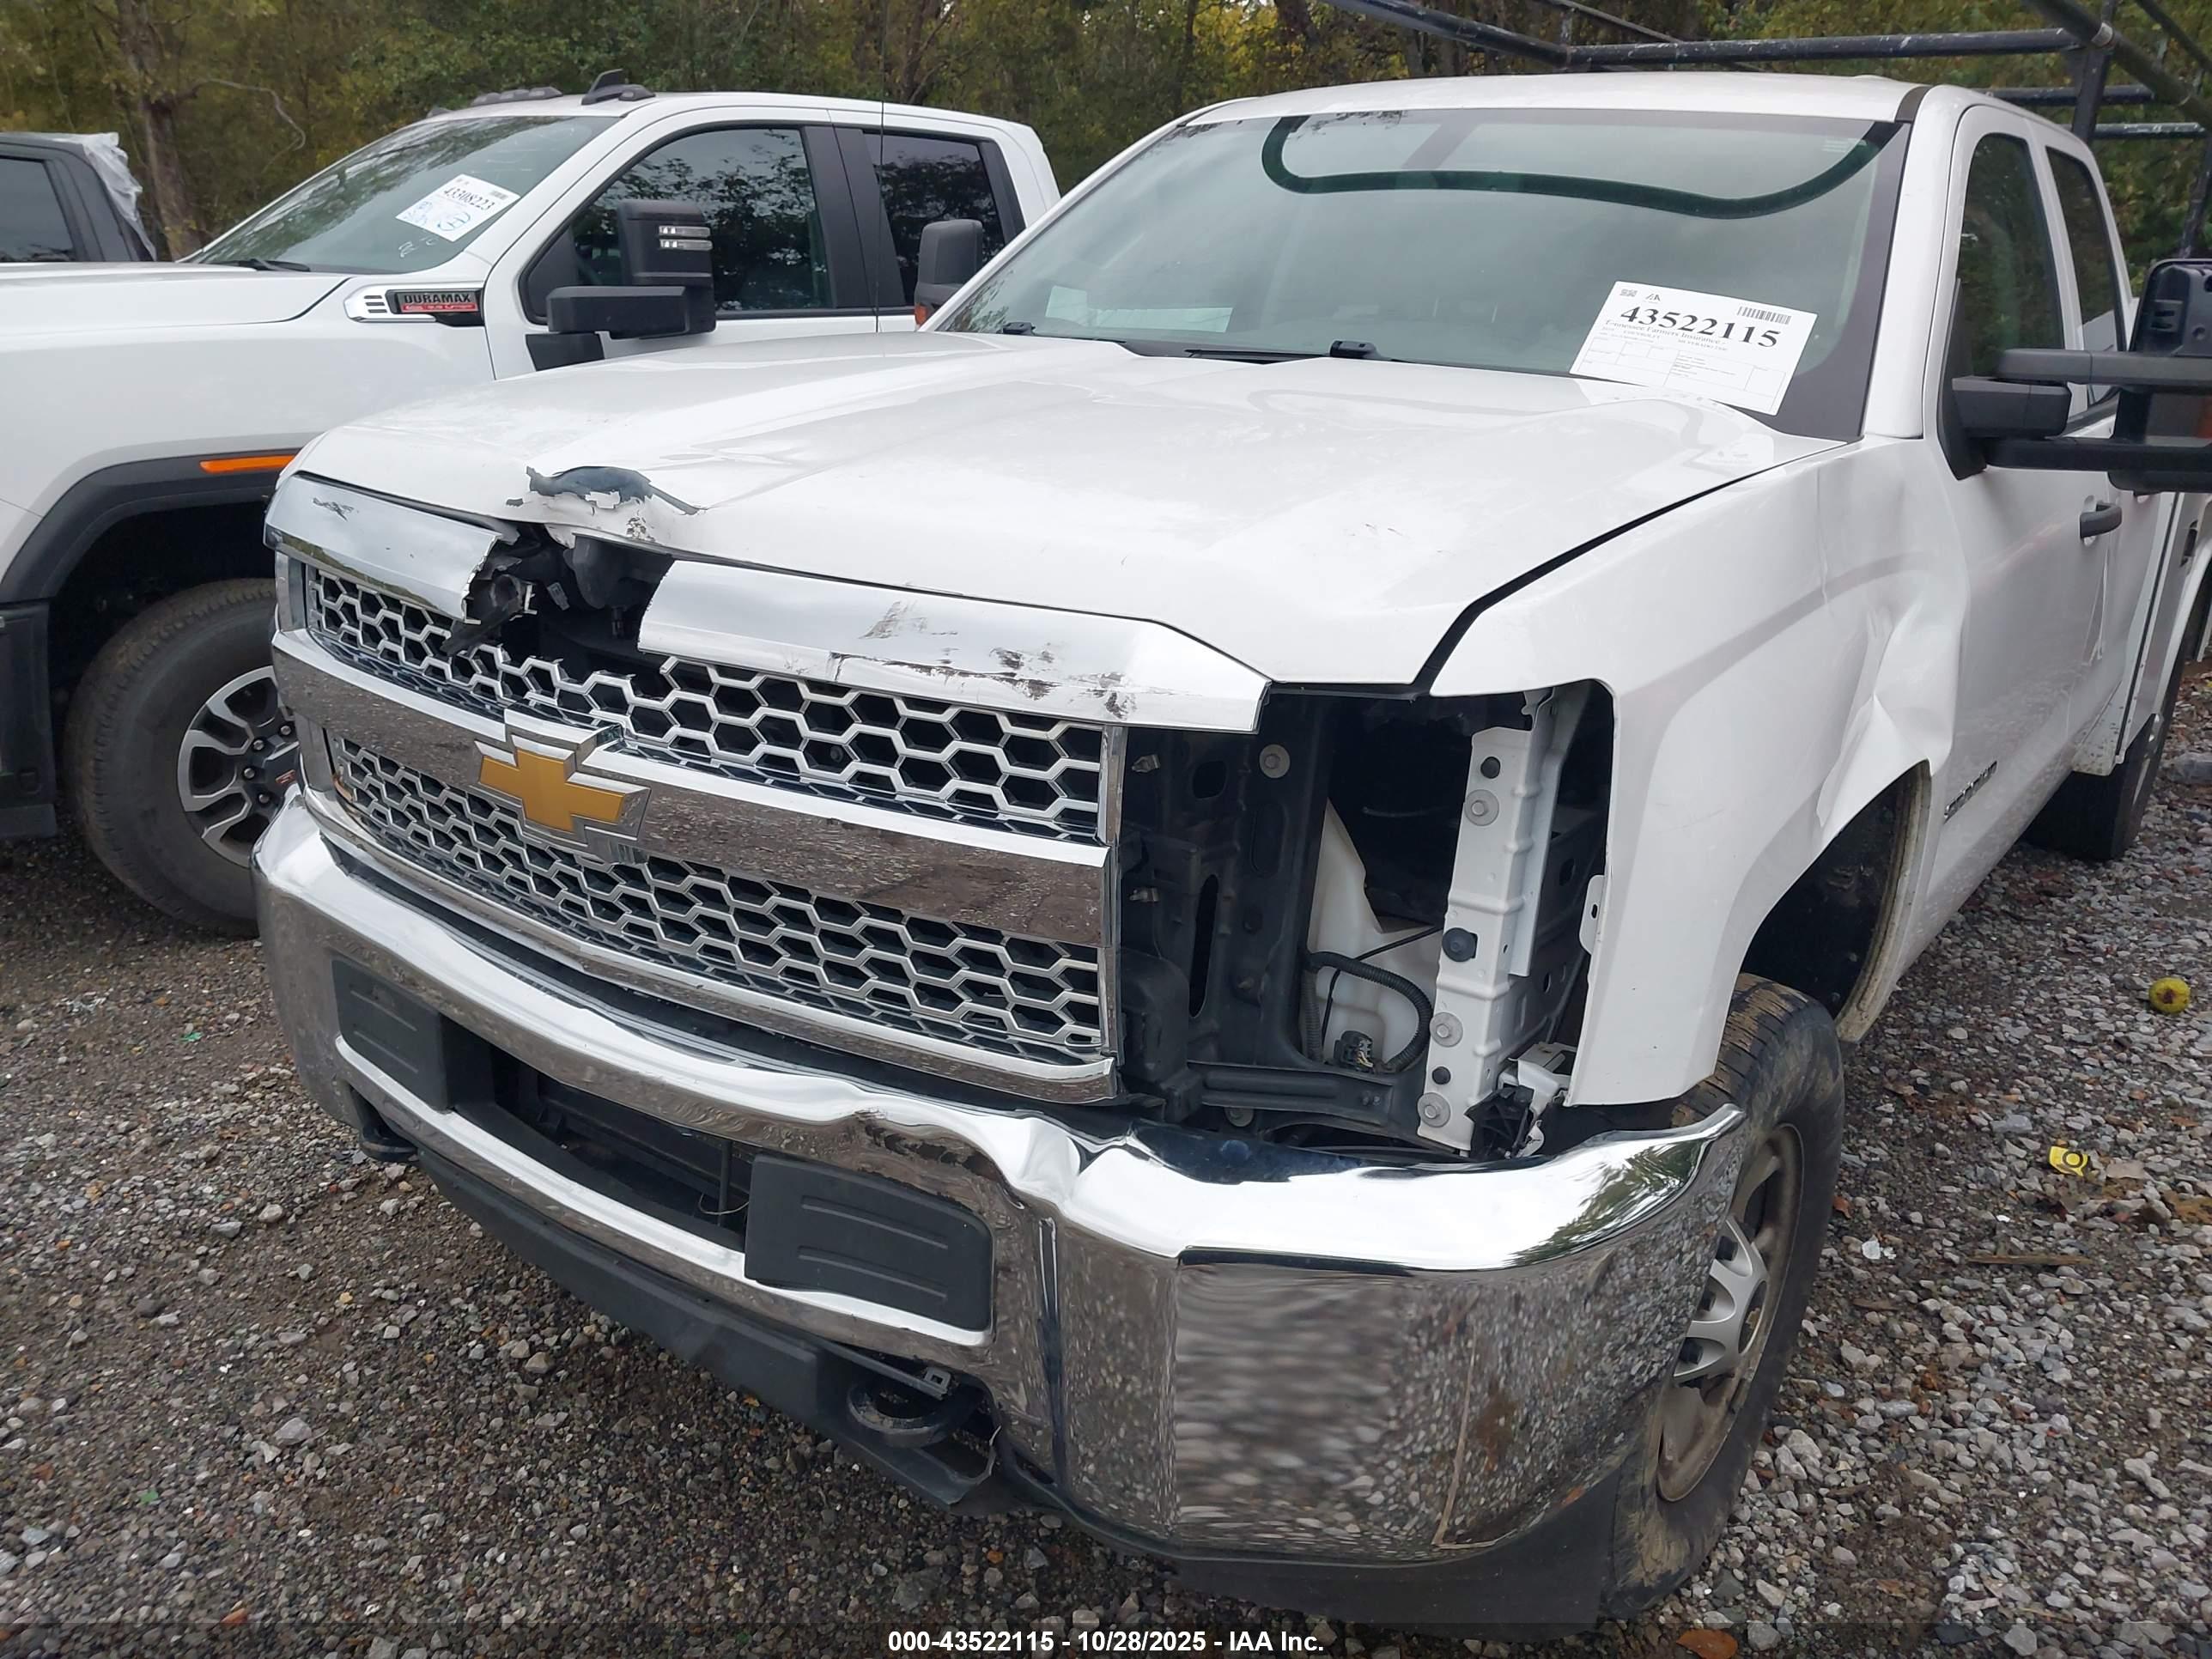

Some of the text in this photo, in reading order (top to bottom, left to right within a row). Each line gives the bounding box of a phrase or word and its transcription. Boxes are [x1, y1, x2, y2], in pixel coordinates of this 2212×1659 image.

[443, 186, 495, 211] 43308223
[404, 293, 471, 304] DURAMAX
[1620, 305, 1782, 349] 43522115
